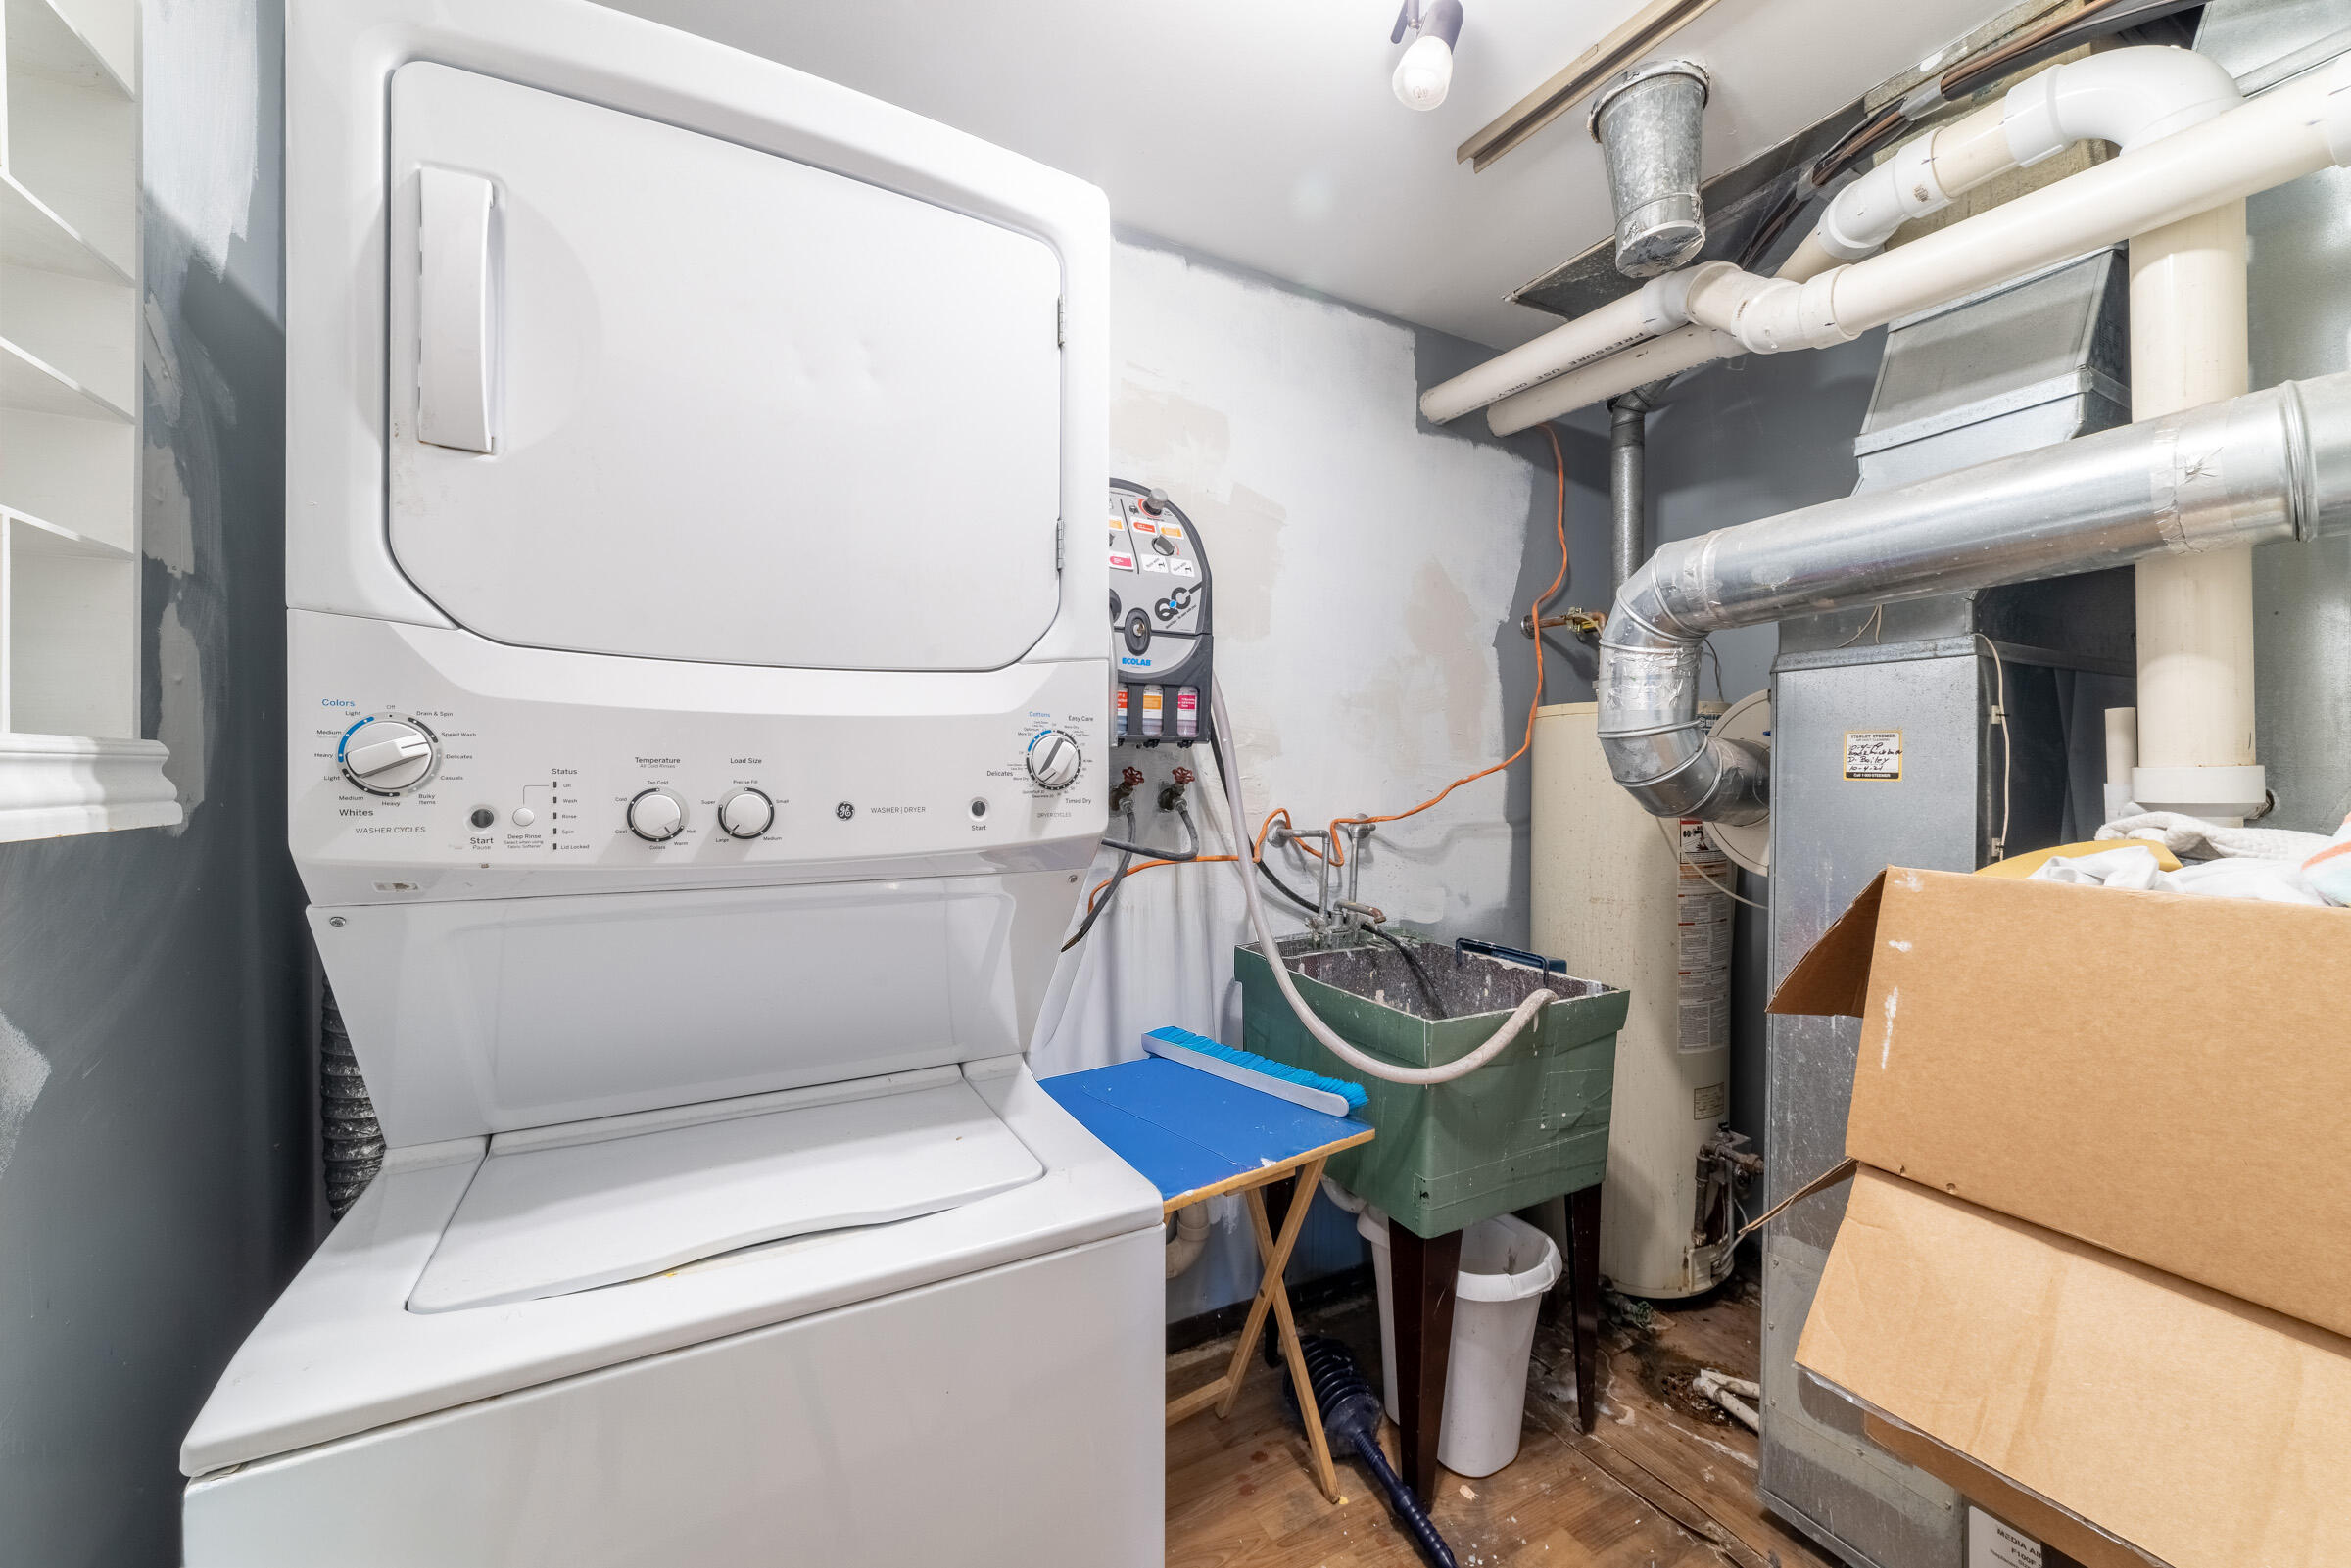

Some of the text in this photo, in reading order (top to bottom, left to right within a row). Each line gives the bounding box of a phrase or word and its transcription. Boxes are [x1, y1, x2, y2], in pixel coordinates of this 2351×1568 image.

[1498, 332, 1644, 398] PRESSURE USE ONLY
[1997, 1529, 2027, 1550] MEDIA
